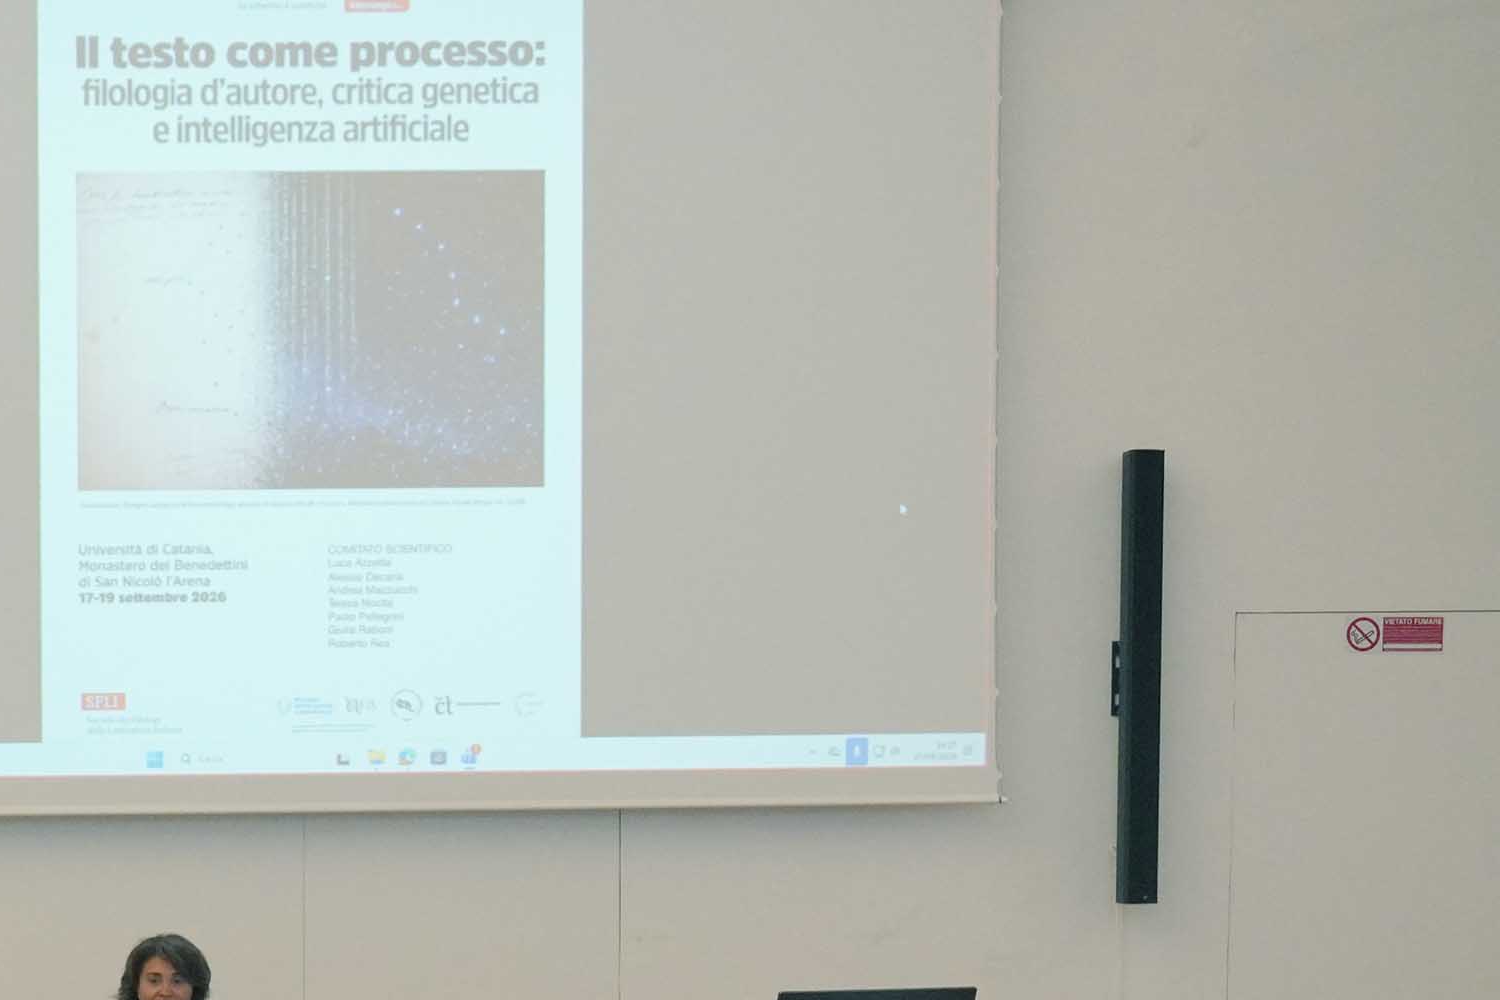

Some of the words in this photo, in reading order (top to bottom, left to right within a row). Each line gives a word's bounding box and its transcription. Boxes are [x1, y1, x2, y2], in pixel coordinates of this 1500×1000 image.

[76, 36, 99, 68] Il
[110, 37, 216, 68] testo
[226, 41, 338, 68] come
[350, 40, 546, 72] processo:
[82, 78, 192, 110] filologia
[200, 78, 324, 108] d'autore,
[332, 77, 414, 105] critica
[422, 77, 539, 109] genetica
[153, 120, 169, 143] e
[177, 115, 335, 147] intelligenza
[343, 114, 470, 142] artificiale
[146, 544, 159, 555] di
[78, 560, 146, 572] Monastero
[150, 560, 170, 571] dei
[174, 559, 249, 571] Benedettini
[78, 576, 91, 588] di
[95, 576, 118, 588] San
[78, 592, 115, 604] 17-19
[118, 592, 188, 603] settembre
